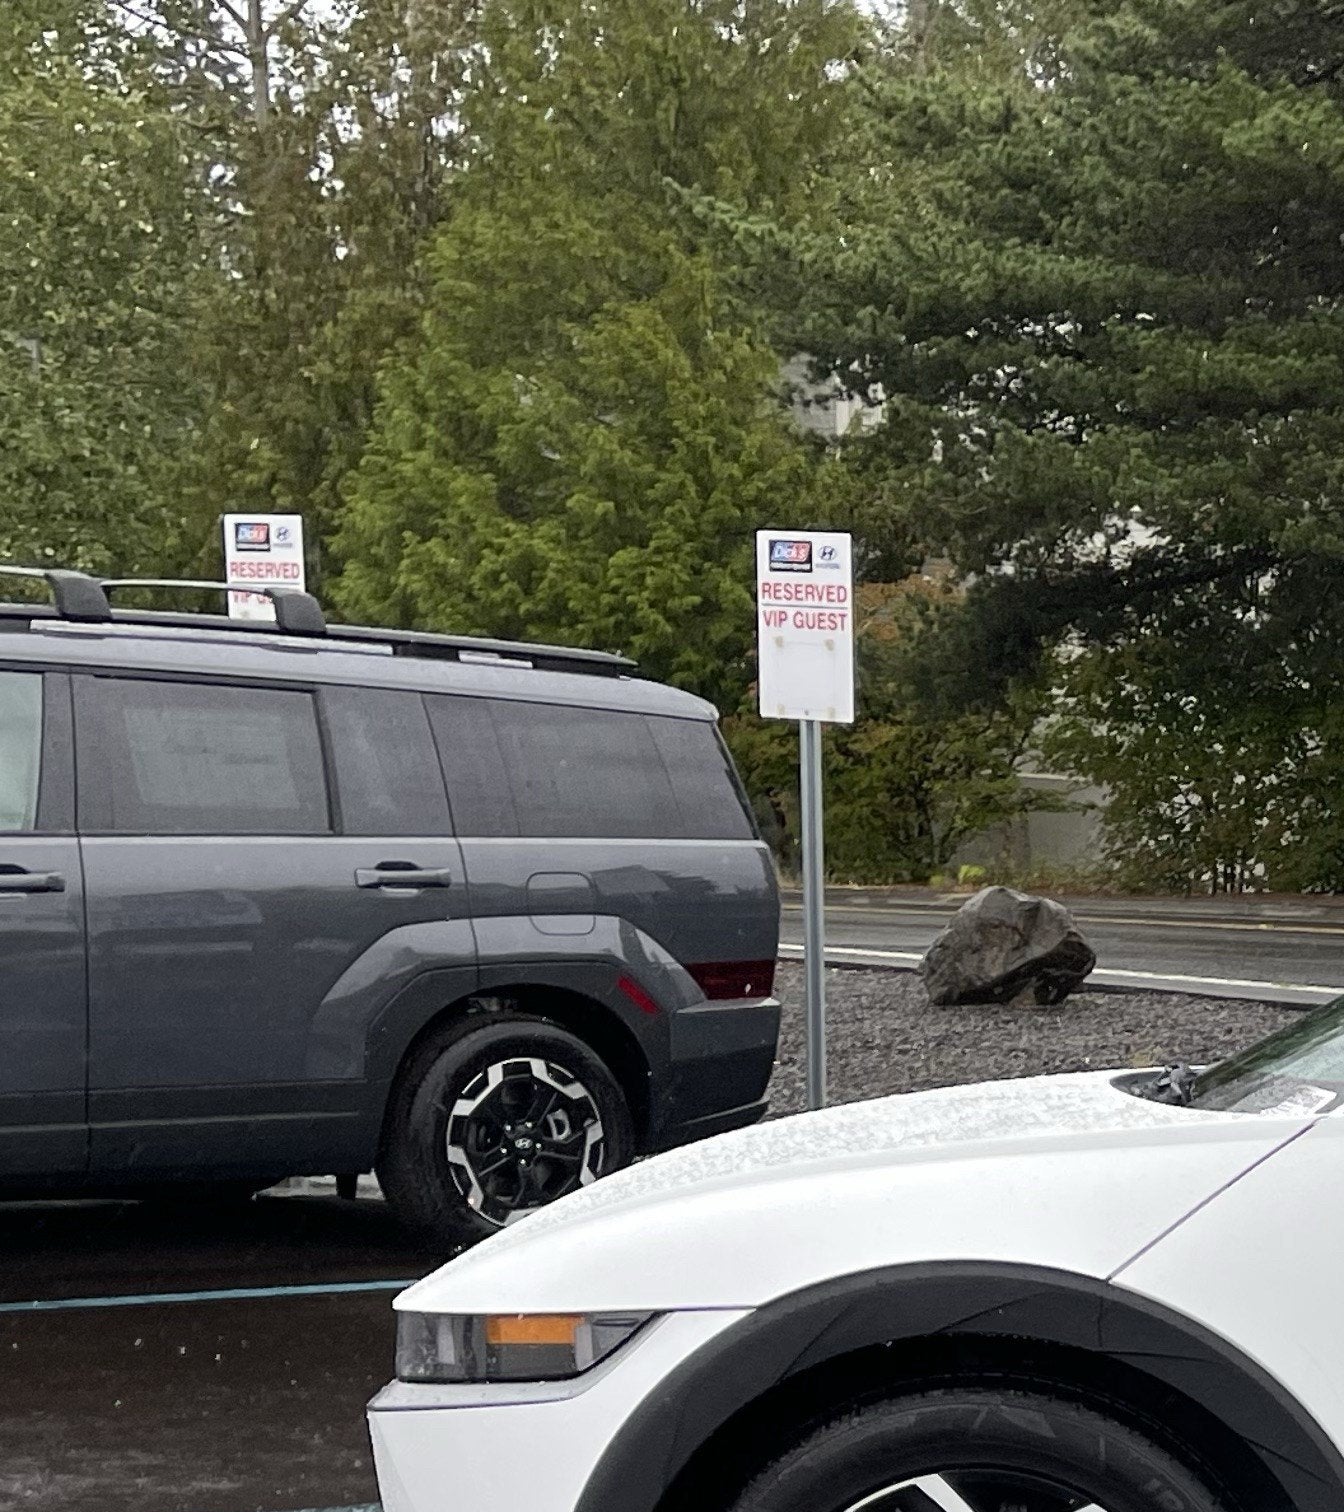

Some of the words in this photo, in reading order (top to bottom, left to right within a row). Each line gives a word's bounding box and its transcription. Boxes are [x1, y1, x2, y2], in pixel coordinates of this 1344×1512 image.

[230, 561, 300, 580] RESERVED
[761, 582, 848, 604] RESERVED
[763, 610, 788, 628] VIP
[793, 611, 848, 632] GUEST
